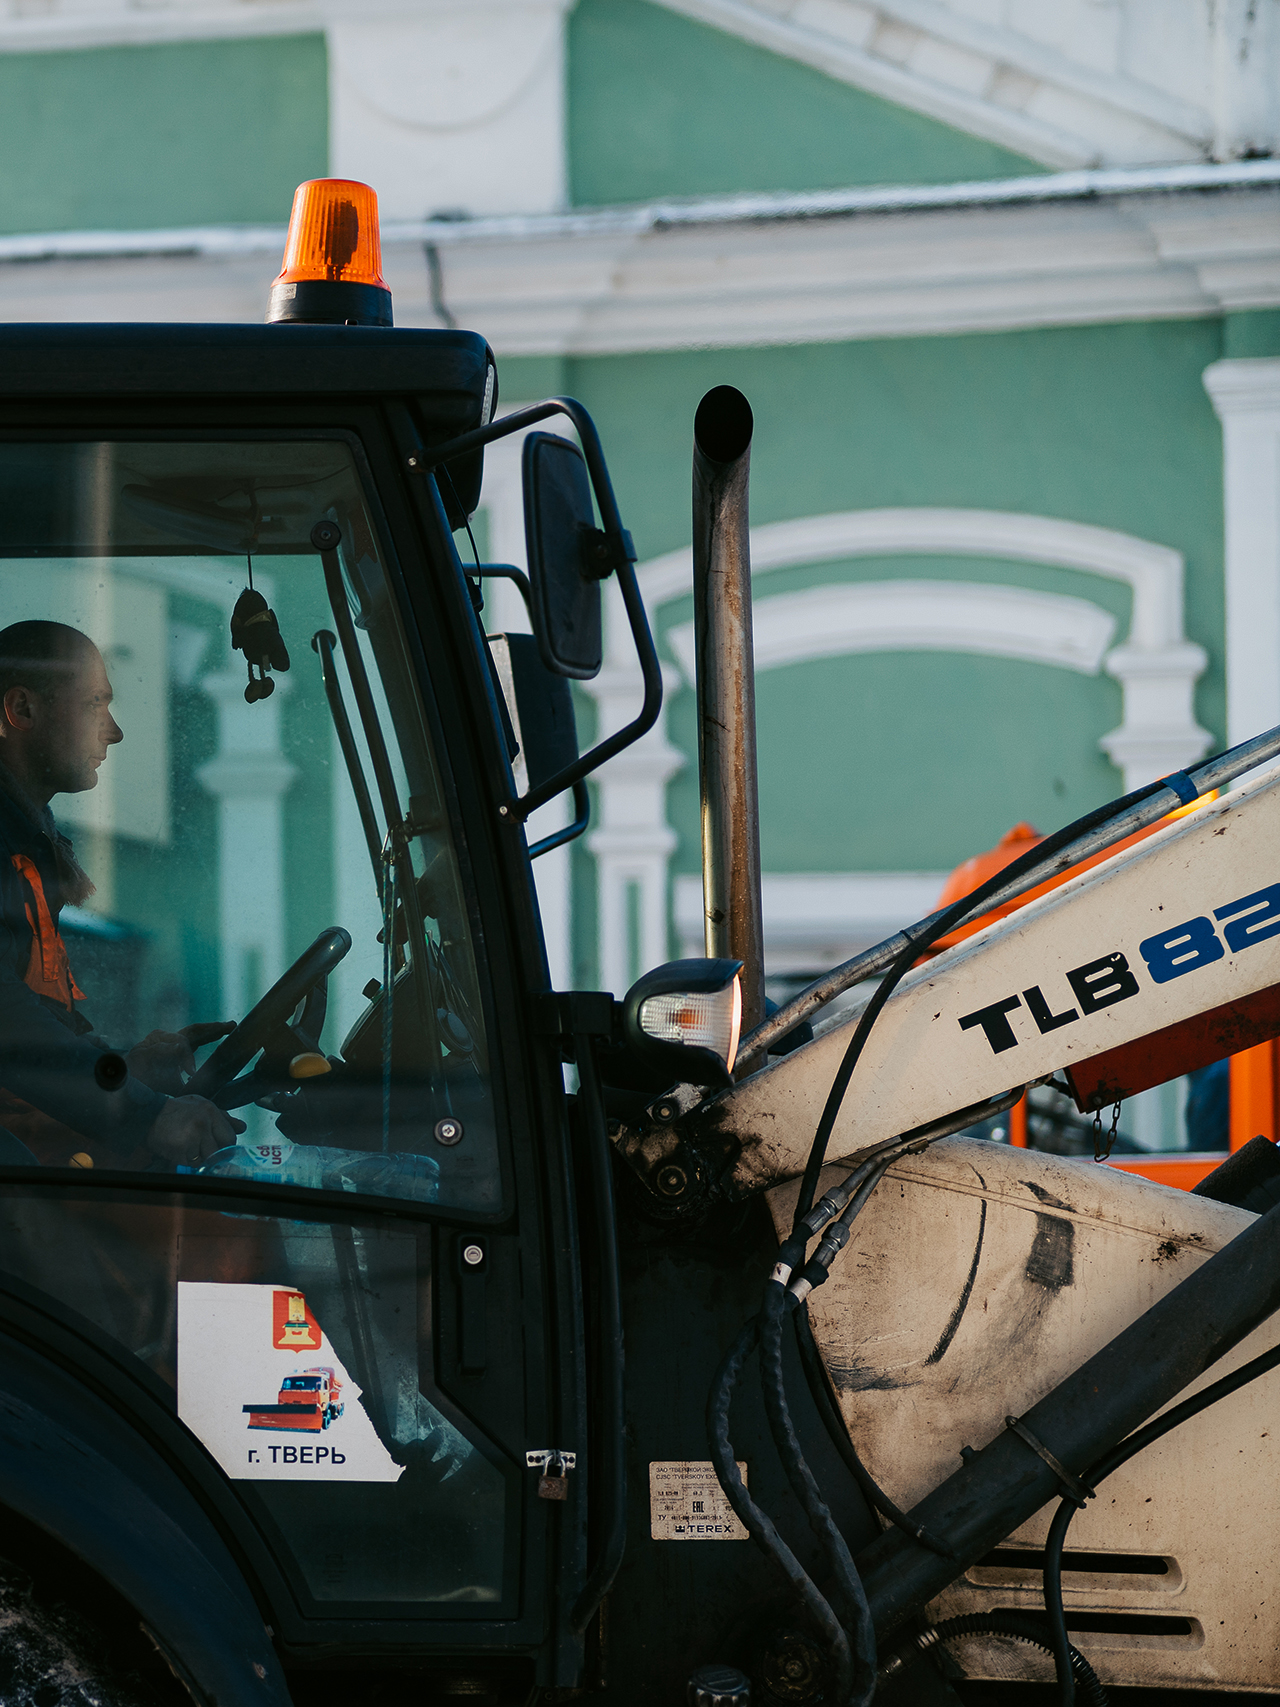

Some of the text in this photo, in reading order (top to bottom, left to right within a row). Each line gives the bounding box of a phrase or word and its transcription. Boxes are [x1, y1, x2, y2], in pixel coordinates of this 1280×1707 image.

[247, 1446, 347, 1465] г. ТВЕРЬ
[688, 1525, 732, 1533] TEREX
